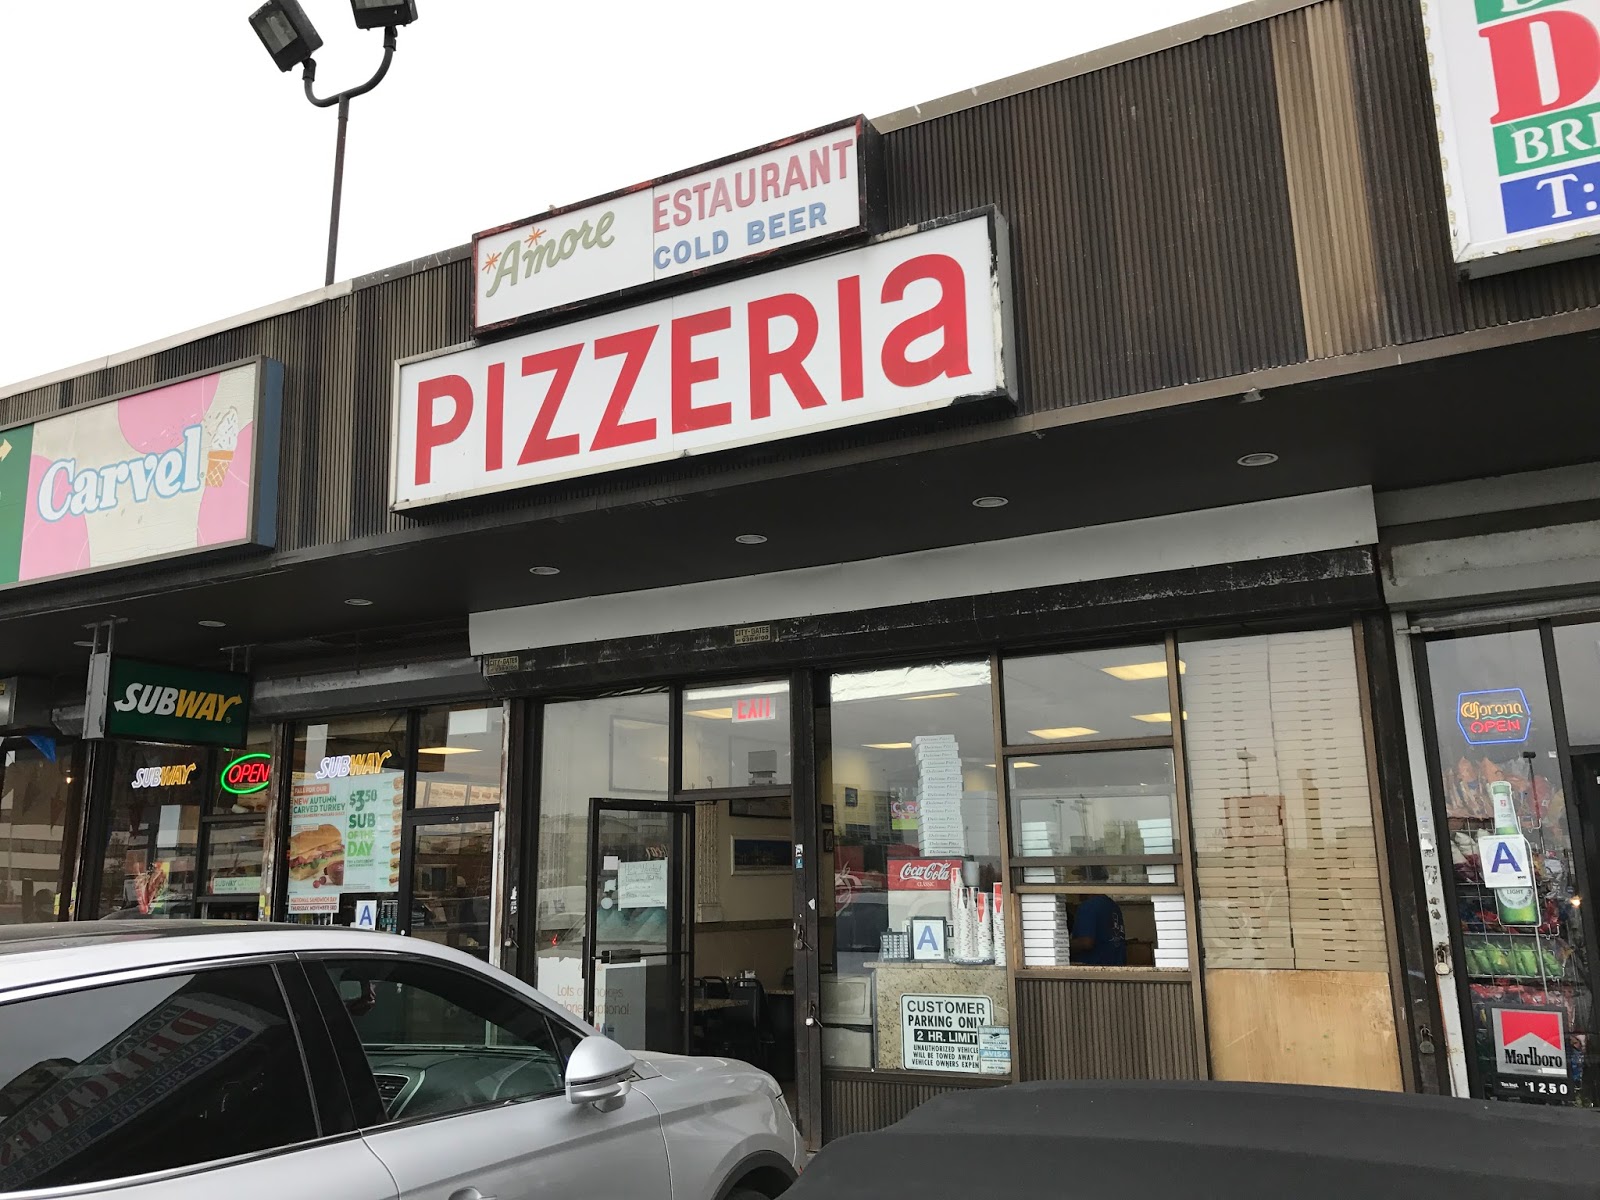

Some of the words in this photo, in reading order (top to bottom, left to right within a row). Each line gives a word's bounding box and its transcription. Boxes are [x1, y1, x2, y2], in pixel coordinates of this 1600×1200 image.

[653, 138, 854, 234] ESTAURANT
[1536, 172, 1598, 219] T:
[654, 229, 729, 270] COLD
[746, 201, 828, 246] BEER
[485, 210, 616, 298] Amore
[37, 423, 202, 523] Carvel
[114, 683, 242, 722] SUBWAY
[1460, 700, 1523, 719] Corona
[1470, 719, 1520, 734] OPEN
[228, 763, 270, 784] OPEN
[315, 750, 392, 779] SUBWAY
[131, 762, 197, 789] SUBWAY
[293, 797, 309, 805] NEW
[310, 795, 337, 804] AUTUMN
[293, 805, 319, 814] CARVED
[319, 803, 346, 812] TURKEY
[348, 812, 376, 828] SUB
[347, 830, 359, 839] OF
[347, 841, 374, 857] DAY
[1491, 841, 1522, 873] A
[900, 862, 951, 880] Coca-Cola
[359, 905, 373, 925] A
[917, 925, 938, 951] A
[557, 984, 574, 997] Lots
[907, 1000, 985, 1014] CUSTOMER
[908, 1015, 952, 1028] PARKING
[958, 1016, 985, 1029] ONLY
[916, 1031, 924, 1041] 2
[928, 1032, 946, 1042] HR.
[948, 1032, 978, 1043] LIMIT
[913, 1044, 955, 1053] UNAUTHORIZED
[957, 1045, 979, 1054] VEHICLE
[913, 1051, 925, 1059] WILL
[936, 1052, 955, 1060] TOWED
[957, 1053, 974, 1061] AWAY
[981, 1050, 1009, 1058] AVISO
[1504, 1046, 1562, 1068] Marlboro
[936, 1060, 959, 1068] OWNERS
